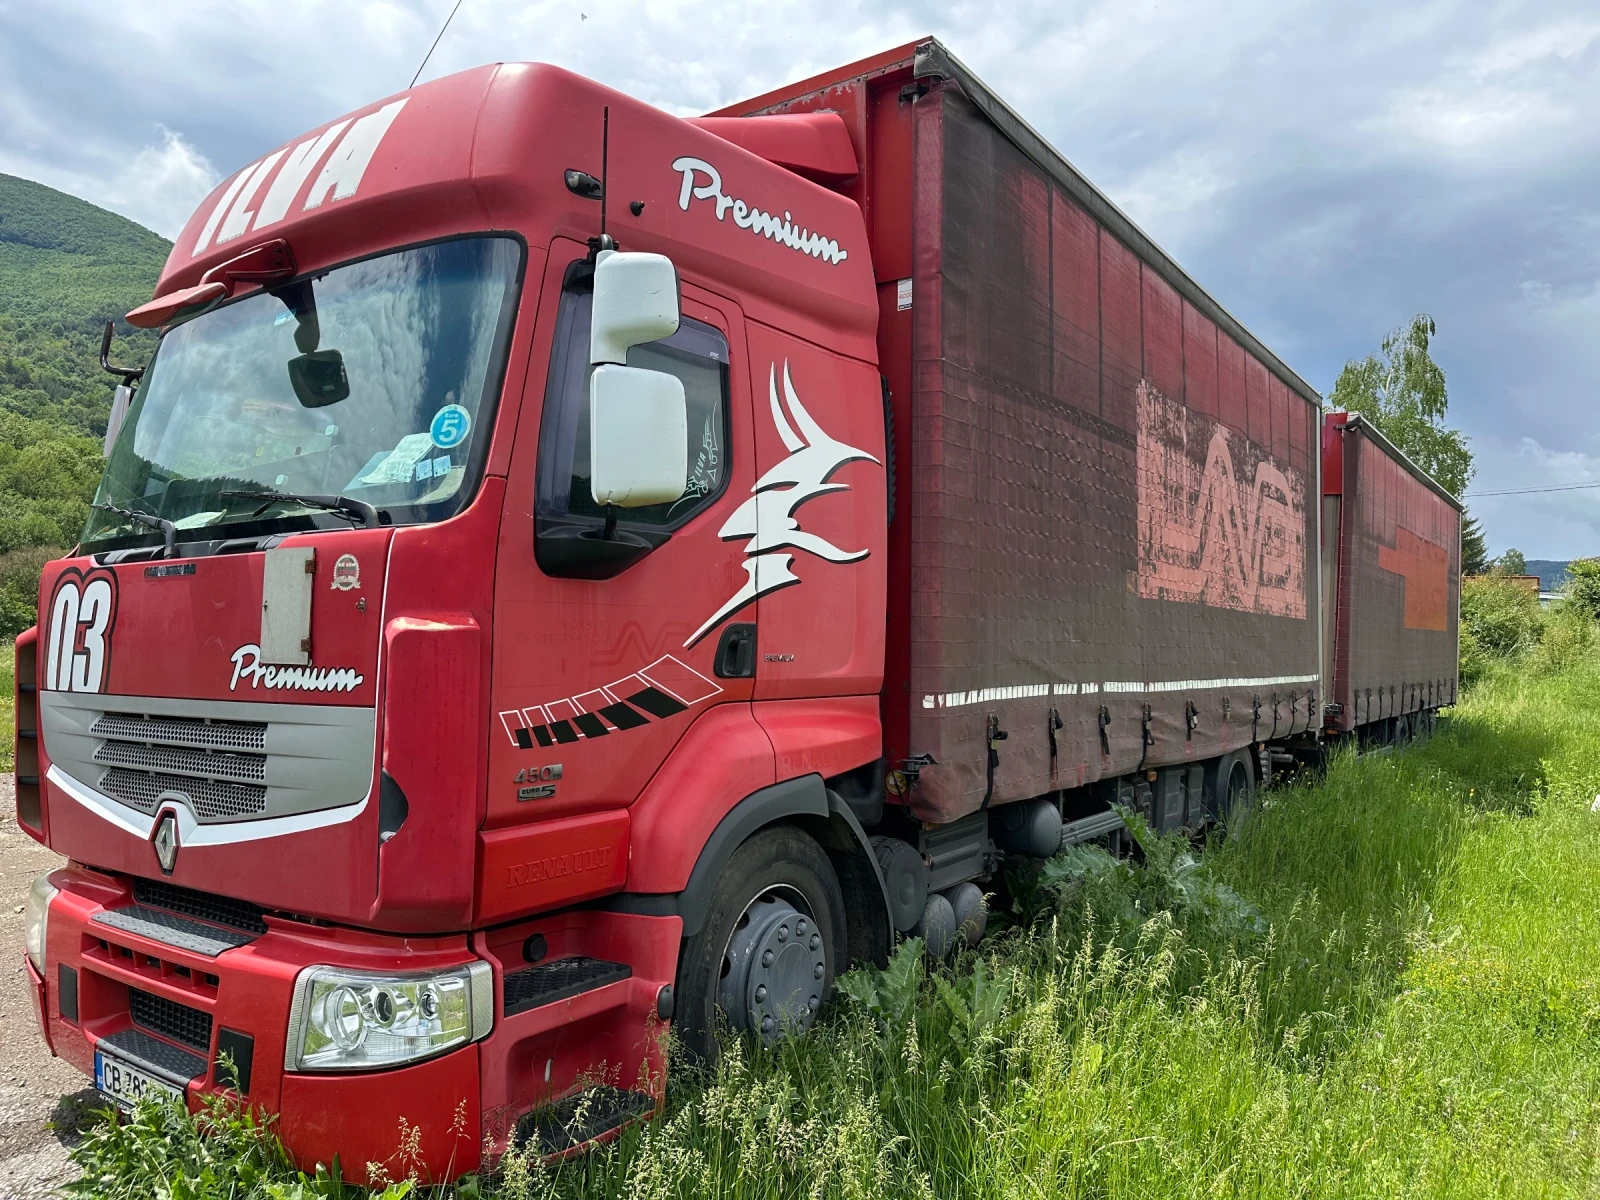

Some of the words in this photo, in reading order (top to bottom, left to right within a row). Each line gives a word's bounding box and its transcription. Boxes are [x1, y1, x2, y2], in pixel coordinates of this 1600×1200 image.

[191, 96, 411, 258] ILVA
[672, 156, 848, 265] Premium
[439, 418, 459, 442] 5
[46, 579, 113, 693] 03
[229, 643, 364, 693] Premium
[513, 765, 551, 784] 450
[507, 846, 611, 889] RENAULT
